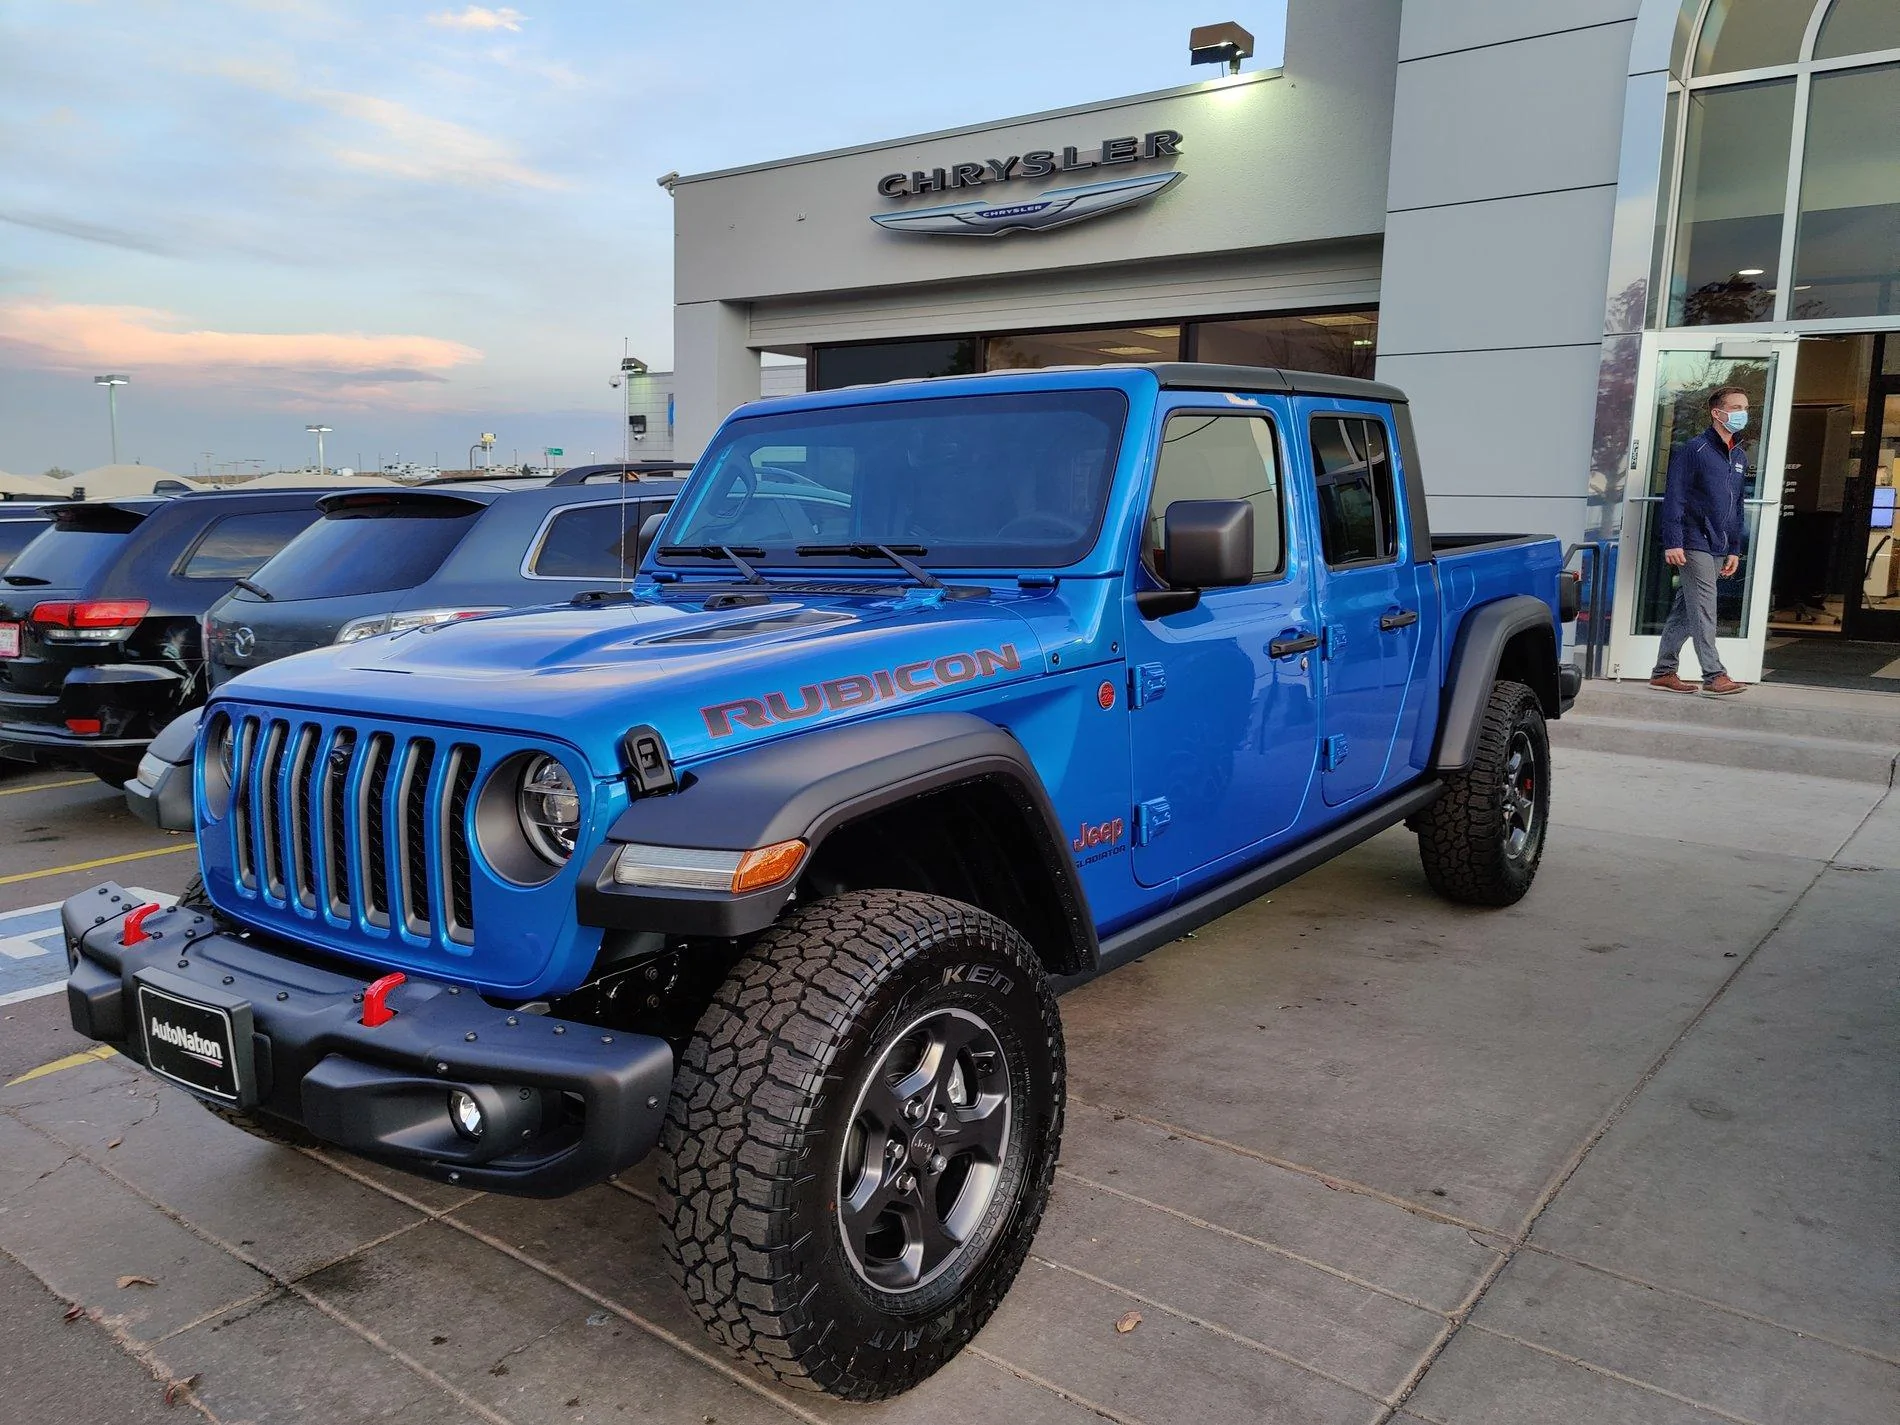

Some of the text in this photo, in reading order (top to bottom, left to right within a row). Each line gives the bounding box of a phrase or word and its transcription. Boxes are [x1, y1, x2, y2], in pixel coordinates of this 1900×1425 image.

[878, 130, 1184, 197] CHRYSLER
[982, 205, 1042, 217] CHRYSLER
[700, 643, 1021, 738] RUBICON
[1073, 817, 1123, 851] Jeep
[152, 1017, 223, 1059] AutoNation
